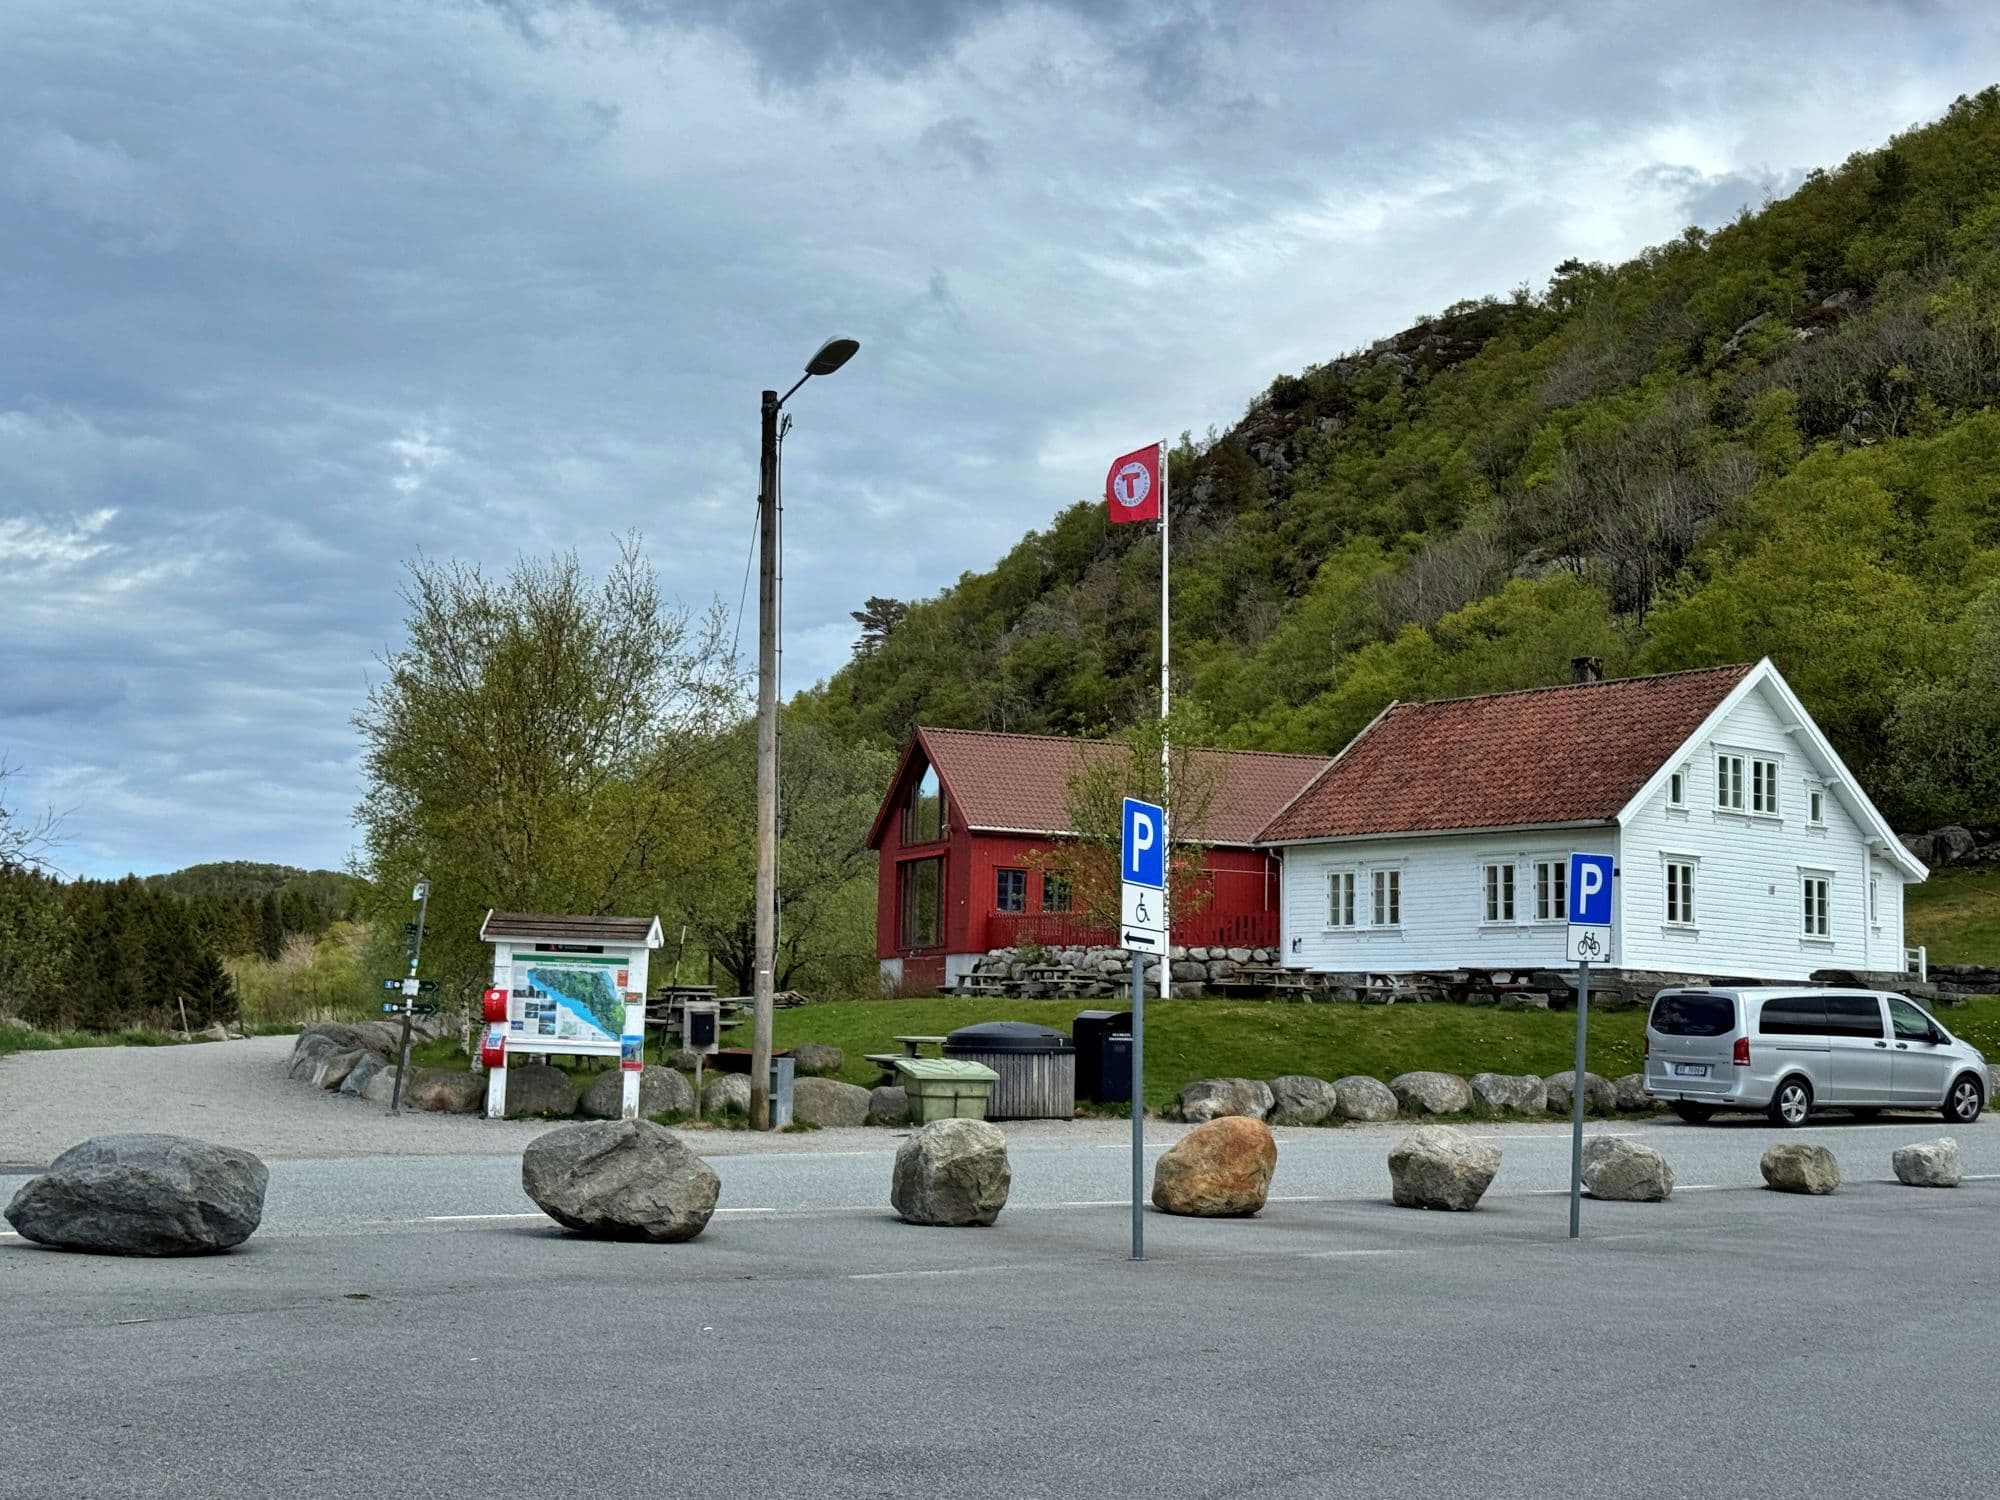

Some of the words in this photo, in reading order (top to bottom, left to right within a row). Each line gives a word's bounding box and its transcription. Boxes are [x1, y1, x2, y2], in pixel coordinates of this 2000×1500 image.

[1123, 473, 1140, 498] T
[1133, 812, 1154, 872] P
[1580, 863, 1603, 914] P
